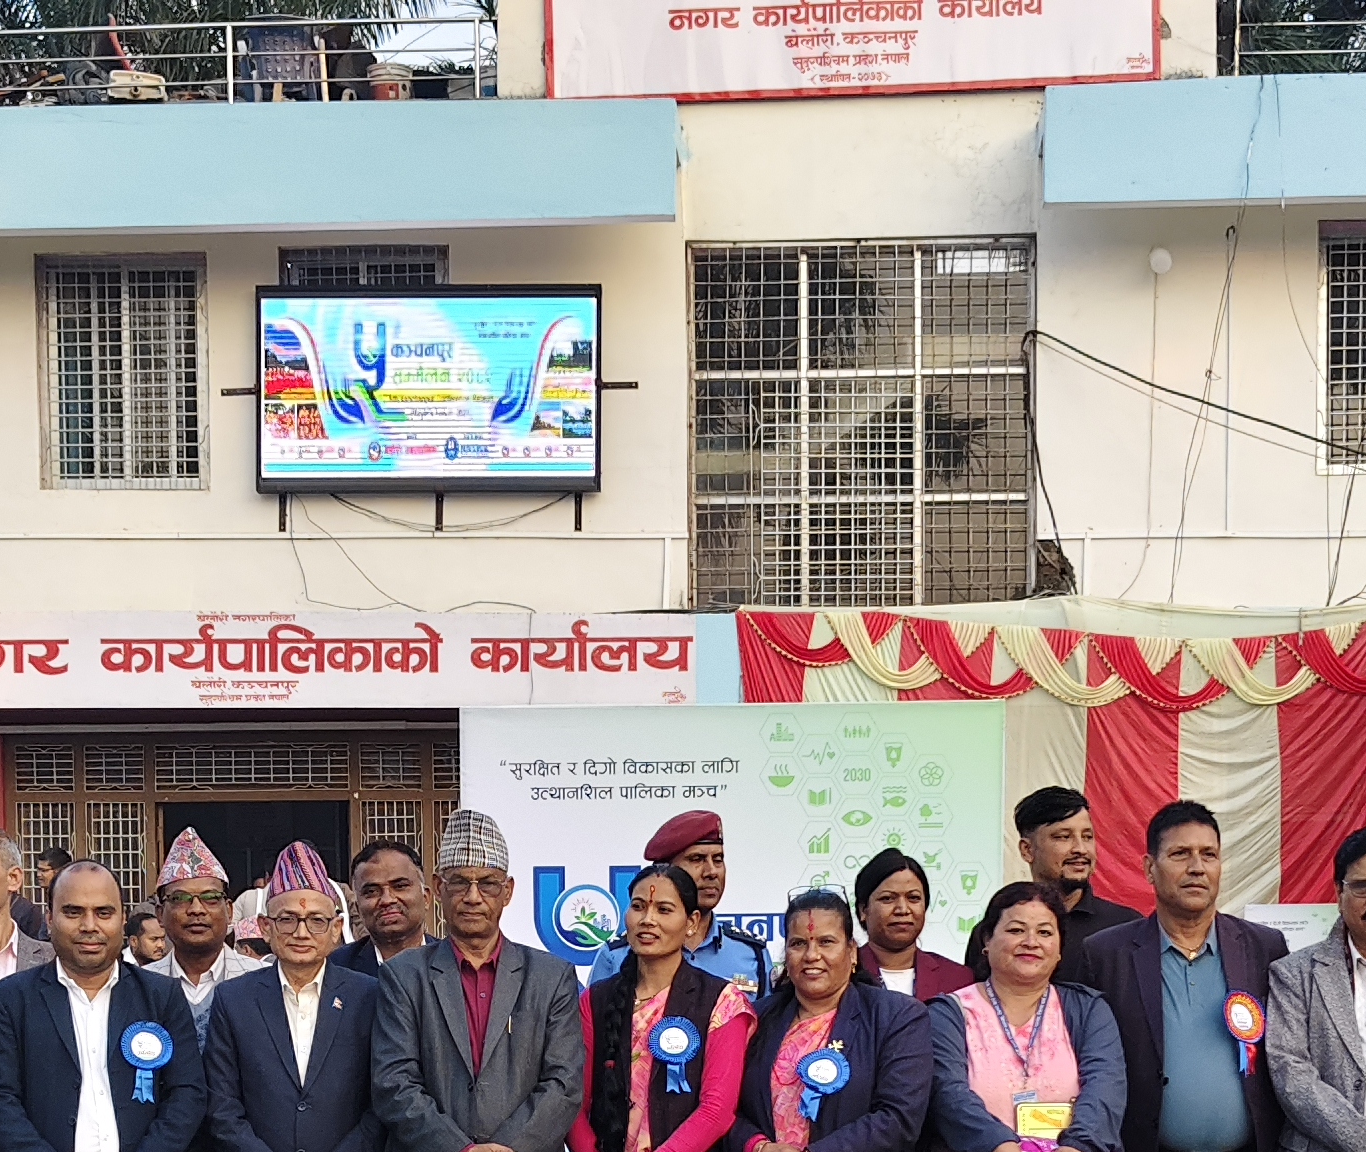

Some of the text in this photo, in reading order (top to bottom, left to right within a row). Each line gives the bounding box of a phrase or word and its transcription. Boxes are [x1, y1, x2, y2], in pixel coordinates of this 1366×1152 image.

[668, 7, 740, 31] नगर
[100, 622, 443, 675] कार्यपालिकाको
[470, 620, 693, 674] कार्यालय
[567, 762, 578, 776] र
[583, 757, 617, 776] दिगो
[623, 758, 696, 775] विकासका
[701, 757, 740, 774] लागि
[843, 768, 871, 782] 2030
[619, 783, 676, 800] पालिका
